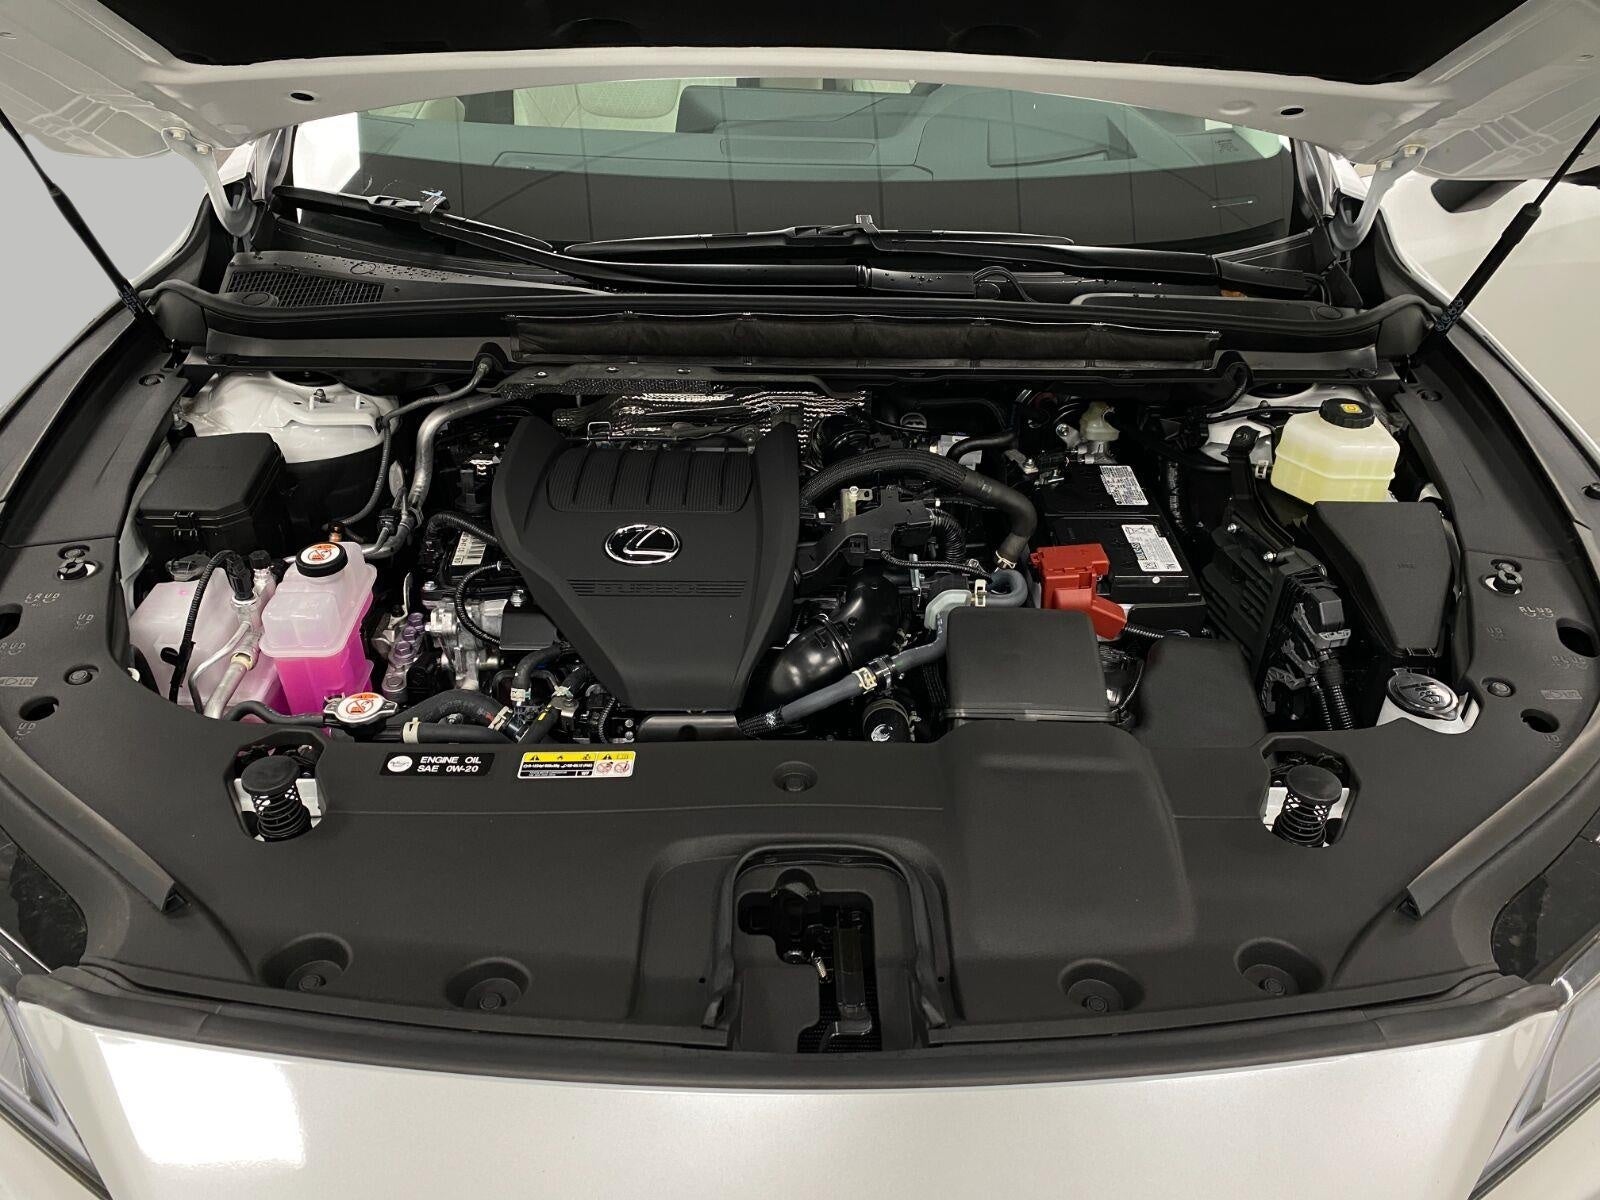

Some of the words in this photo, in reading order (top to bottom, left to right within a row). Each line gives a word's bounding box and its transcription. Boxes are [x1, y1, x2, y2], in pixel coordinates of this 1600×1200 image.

[420, 756, 460, 764] ENGINE
[464, 756, 482, 764] OIL
[417, 765, 440, 773] SAE
[445, 765, 479, 773] 0W-20
